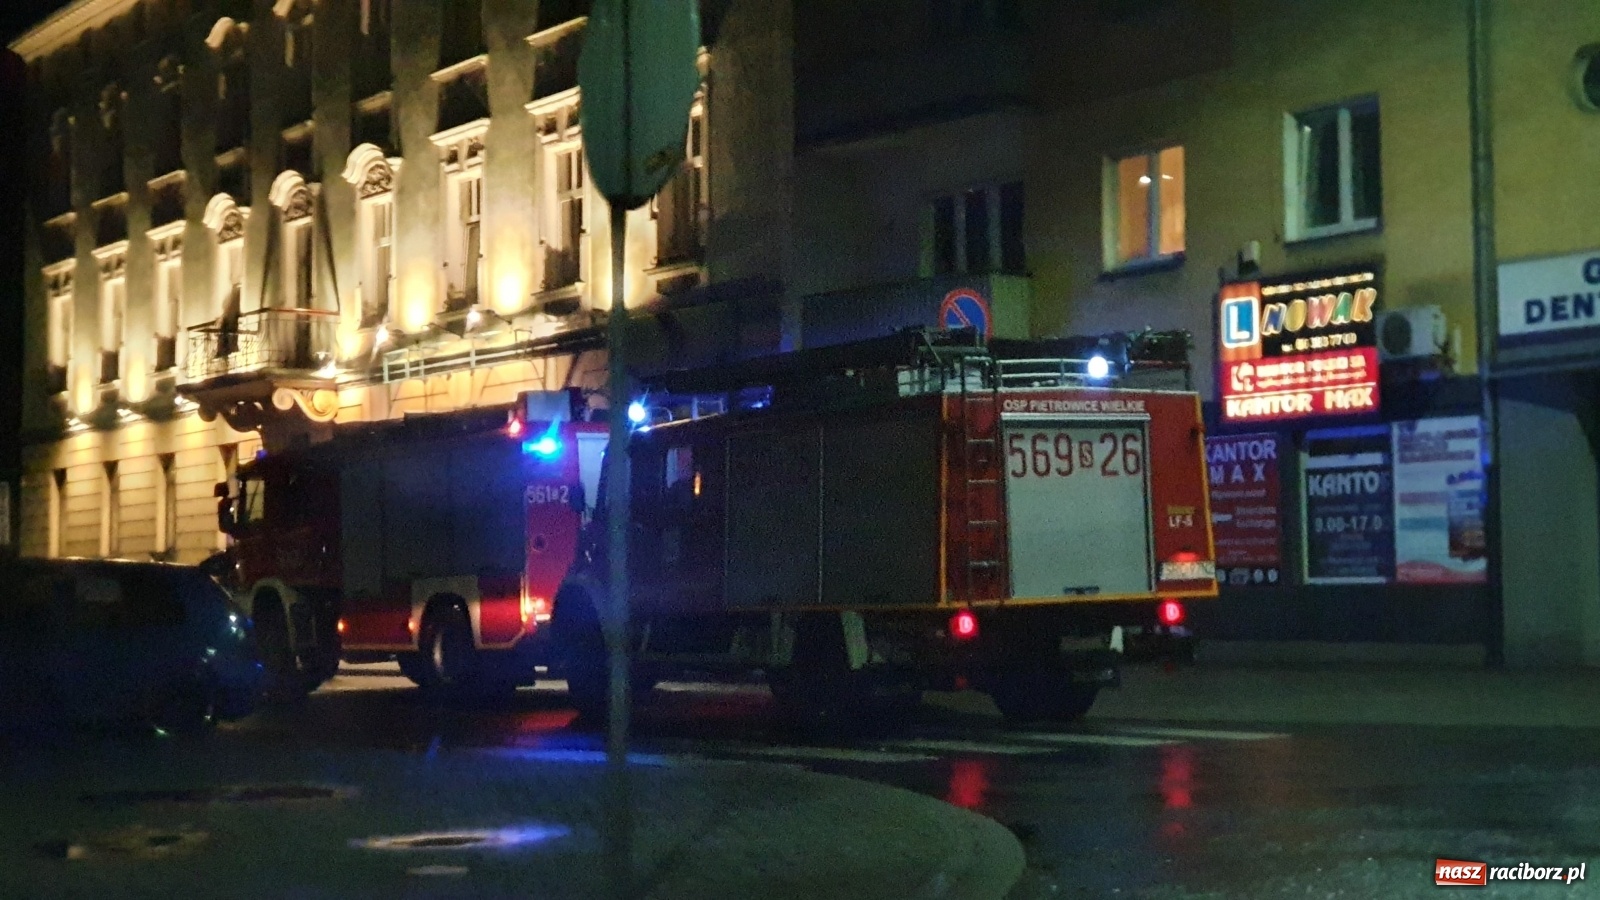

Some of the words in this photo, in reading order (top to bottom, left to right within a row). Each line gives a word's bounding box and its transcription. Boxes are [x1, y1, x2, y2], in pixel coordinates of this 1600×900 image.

[1261, 288, 1377, 335] NOWAK
[1524, 292, 1600, 325] DEN
[1003, 399, 1028, 411] OSP
[1029, 400, 1098, 412] PIETROWICE
[1101, 400, 1146, 411] WIELKIE
[1226, 393, 1313, 418] KANTOR
[1324, 387, 1373, 410] MAX
[1308, 470, 1389, 497] KANTO
